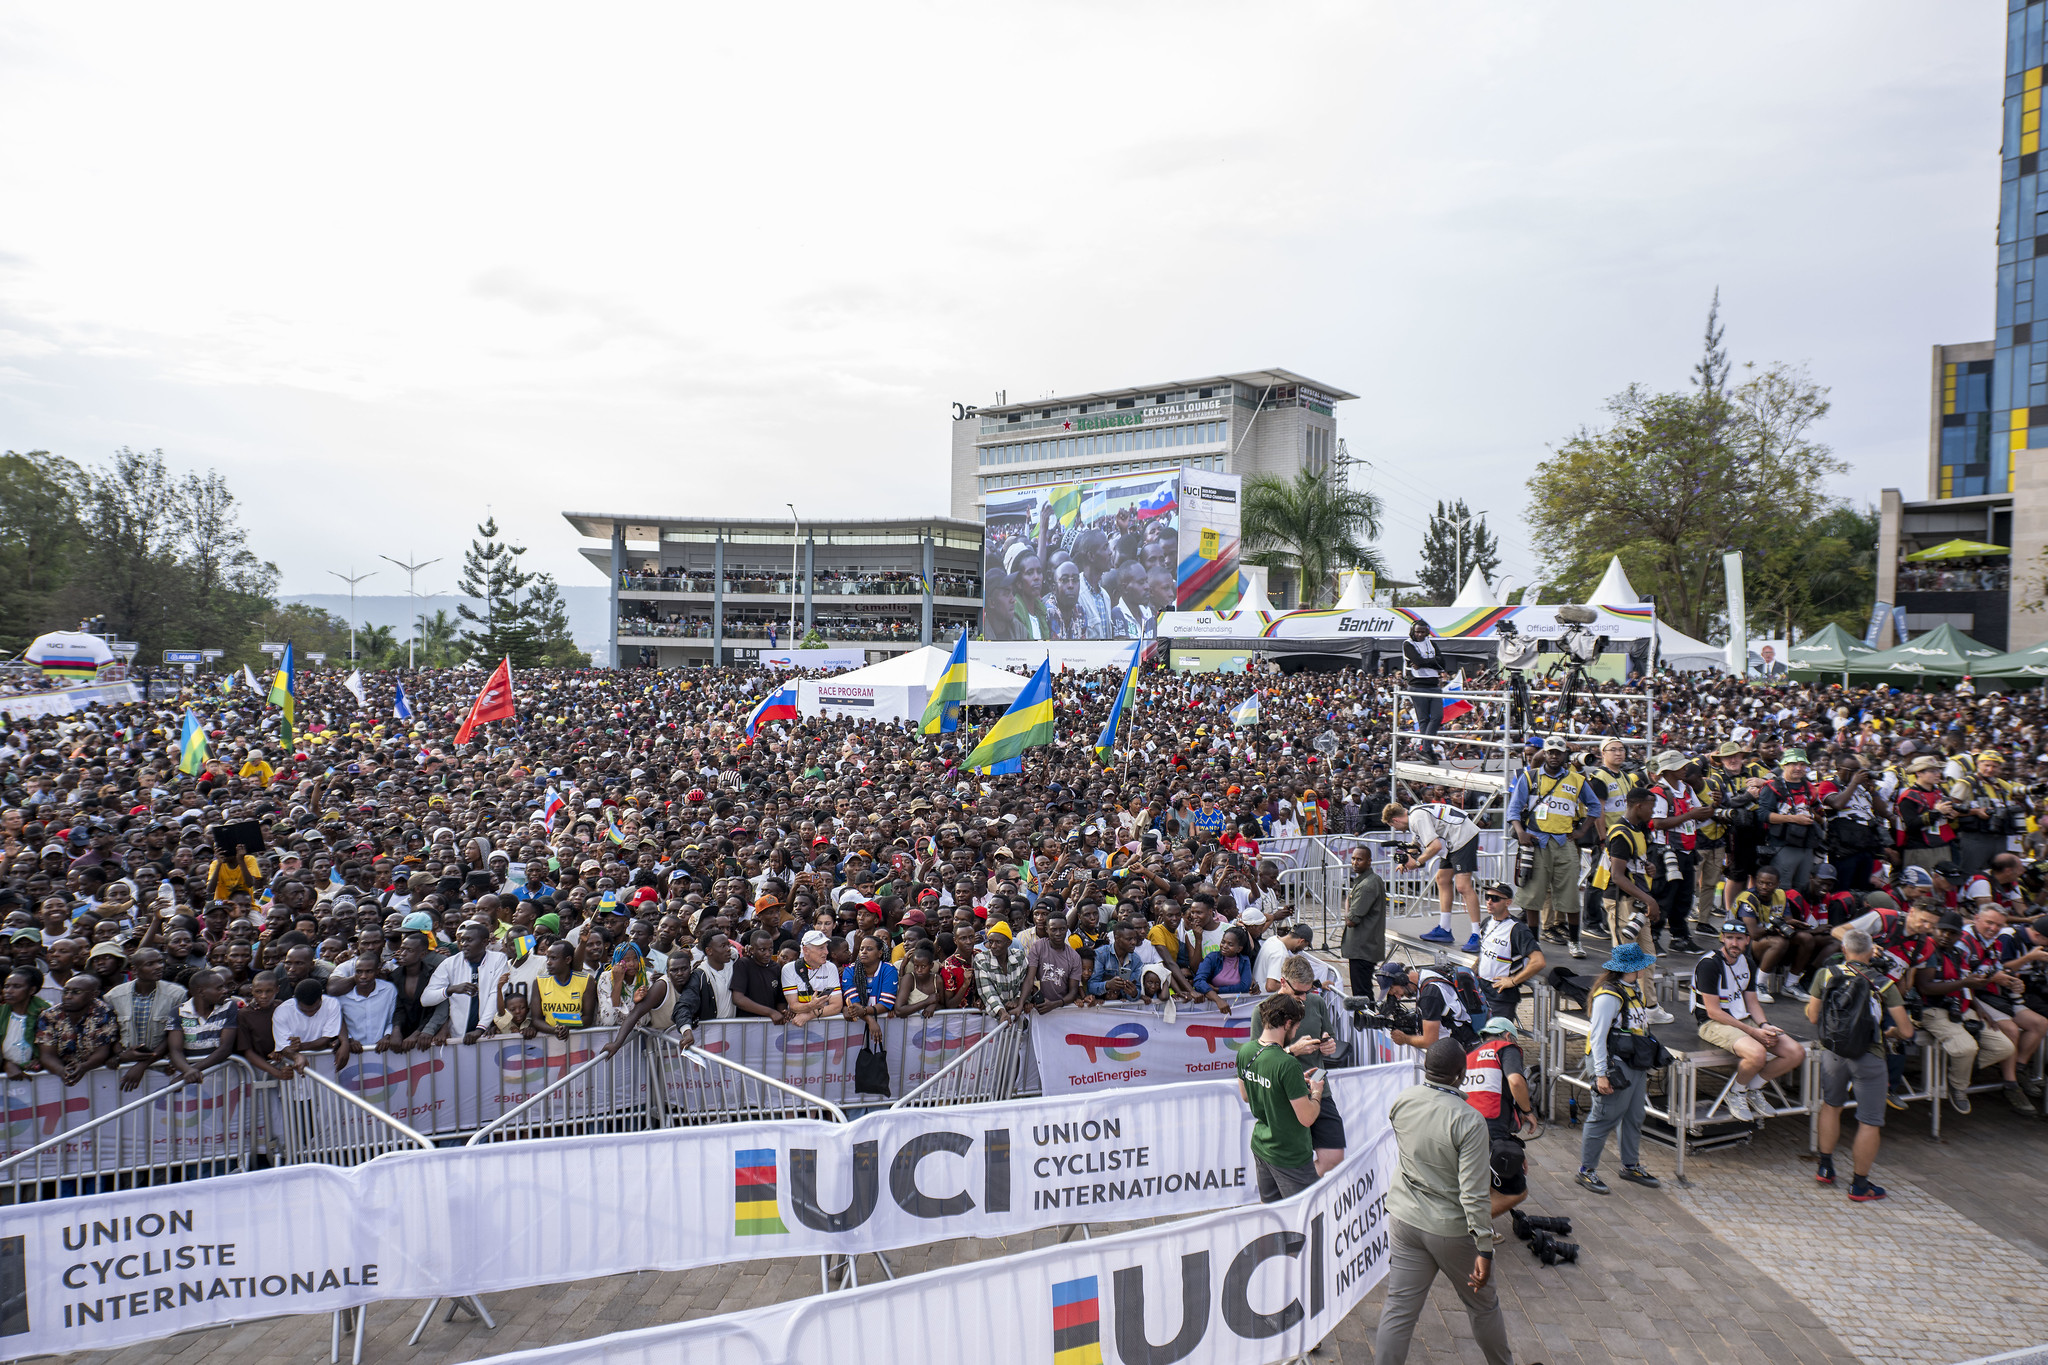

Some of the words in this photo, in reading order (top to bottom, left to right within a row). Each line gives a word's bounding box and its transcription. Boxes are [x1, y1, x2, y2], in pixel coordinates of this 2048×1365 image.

[1143, 404, 1181, 417] CRYSTAL
[1183, 399, 1221, 414] LOUNGE
[1187, 409, 1221, 420] RESTAURANT
[1077, 412, 1143, 432] Heineken
[1187, 486, 1200, 497] UCI
[855, 603, 908, 612] Camellia
[1174, 625, 1193, 634] Official
[1193, 626, 1233, 635] Merchandising
[1199, 617, 1211, 625] UCI
[1338, 616, 1395, 632] Santini
[1527, 624, 1555, 633] Official
[1557, 624, 1620, 634] Mndising
[818, 686, 837, 696] RACE
[838, 687, 874, 697] PROGRAM
[543, 1002, 581, 1012] RWANDA
[1069, 1067, 1147, 1086] TotalEnergies
[1185, 1061, 1237, 1074] TotalEne
[1462, 1074, 1485, 1086] OTO
[1033, 1118, 1121, 1146] UNION
[1033, 1146, 1150, 1180] CYCLISTE
[789, 1128, 1011, 1234] UCI
[1034, 1167, 1247, 1211] INTERNATIONALE
[1333, 1168, 1375, 1222] UNION
[62, 1209, 193, 1252] UNION
[62, 1243, 235, 1290] CYCLISTE
[1336, 1239, 1390, 1297] INTERNA
[63, 1264, 379, 1328] INTERNATIONALE
[1112, 1211, 1325, 1365] UCI
